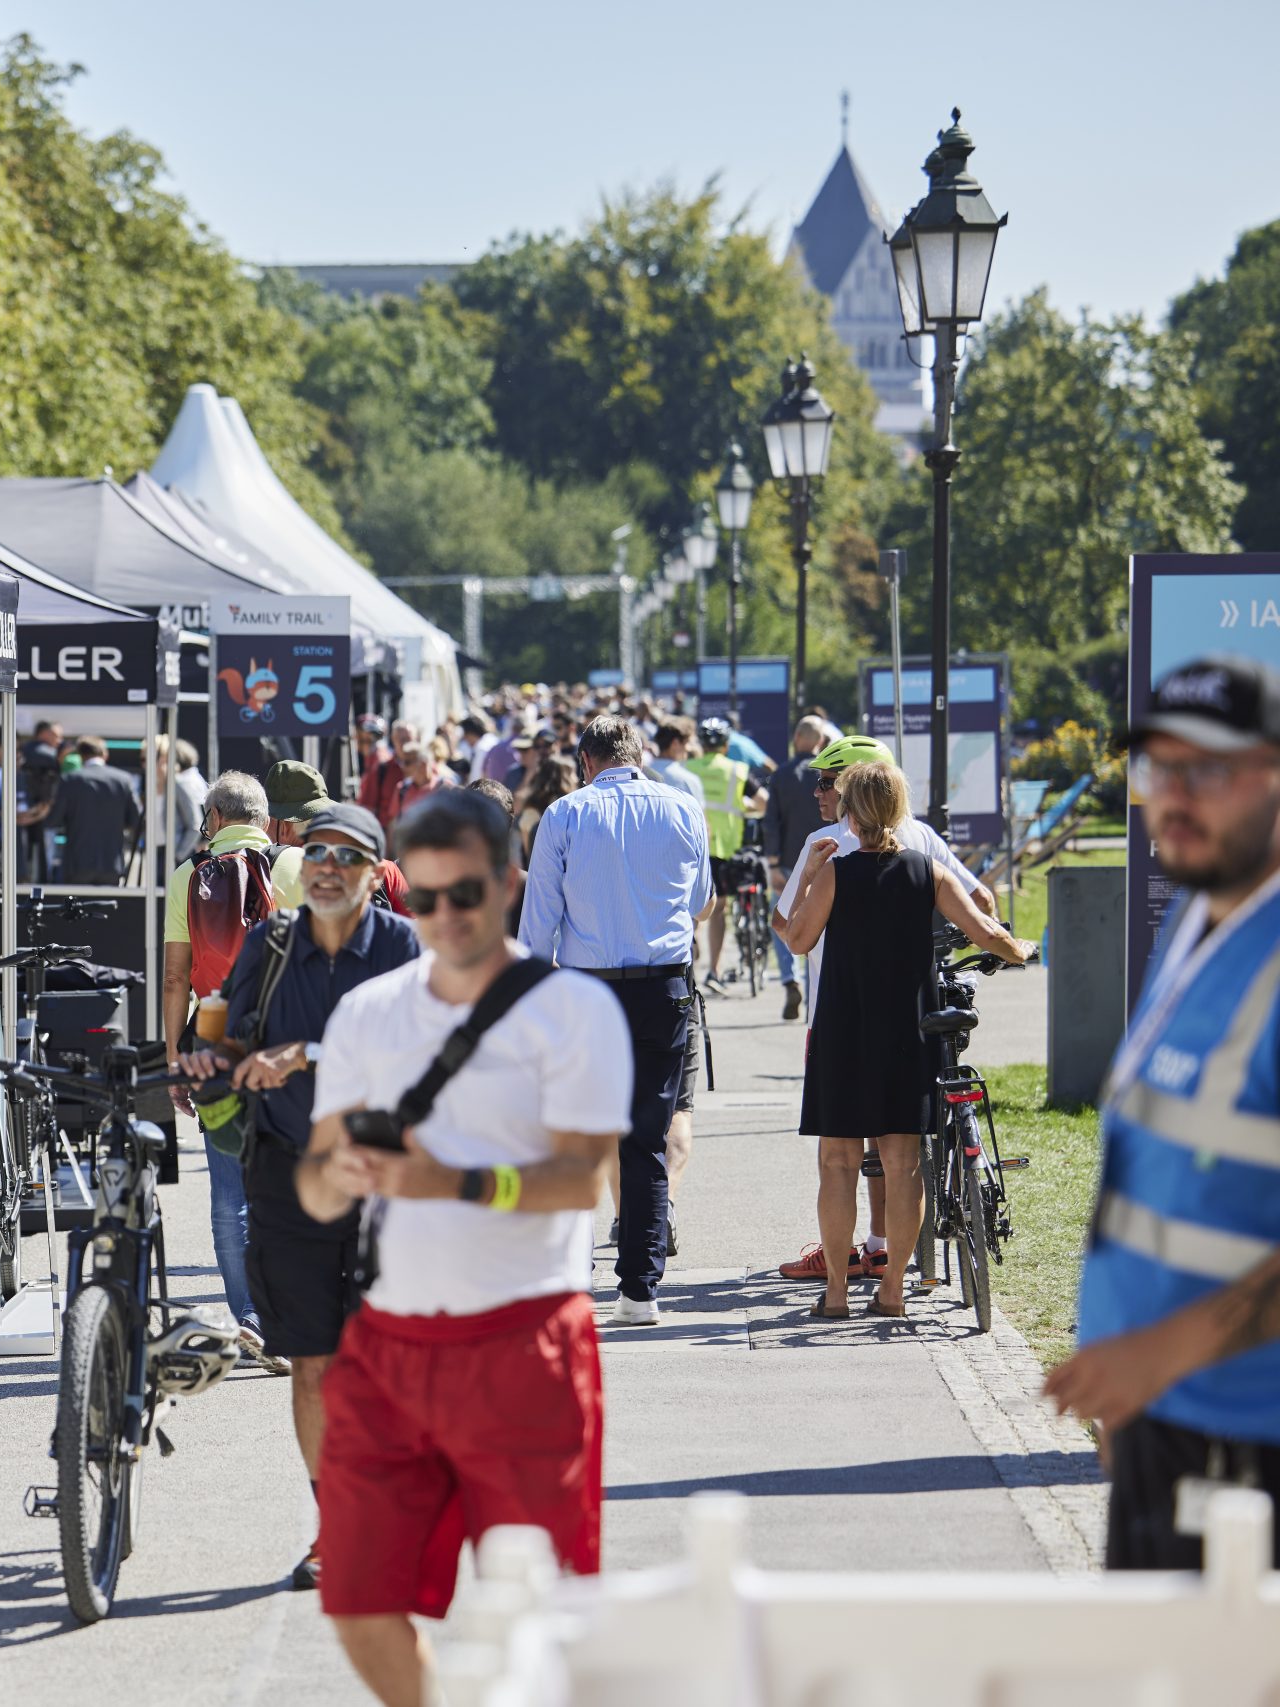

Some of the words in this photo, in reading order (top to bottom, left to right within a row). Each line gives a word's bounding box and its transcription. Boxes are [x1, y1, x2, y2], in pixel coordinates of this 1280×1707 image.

[233, 612, 282, 624] FAMILY
[287, 612, 324, 625] TRAIL
[292, 645, 333, 656] STATION
[292, 665, 336, 724] 5
